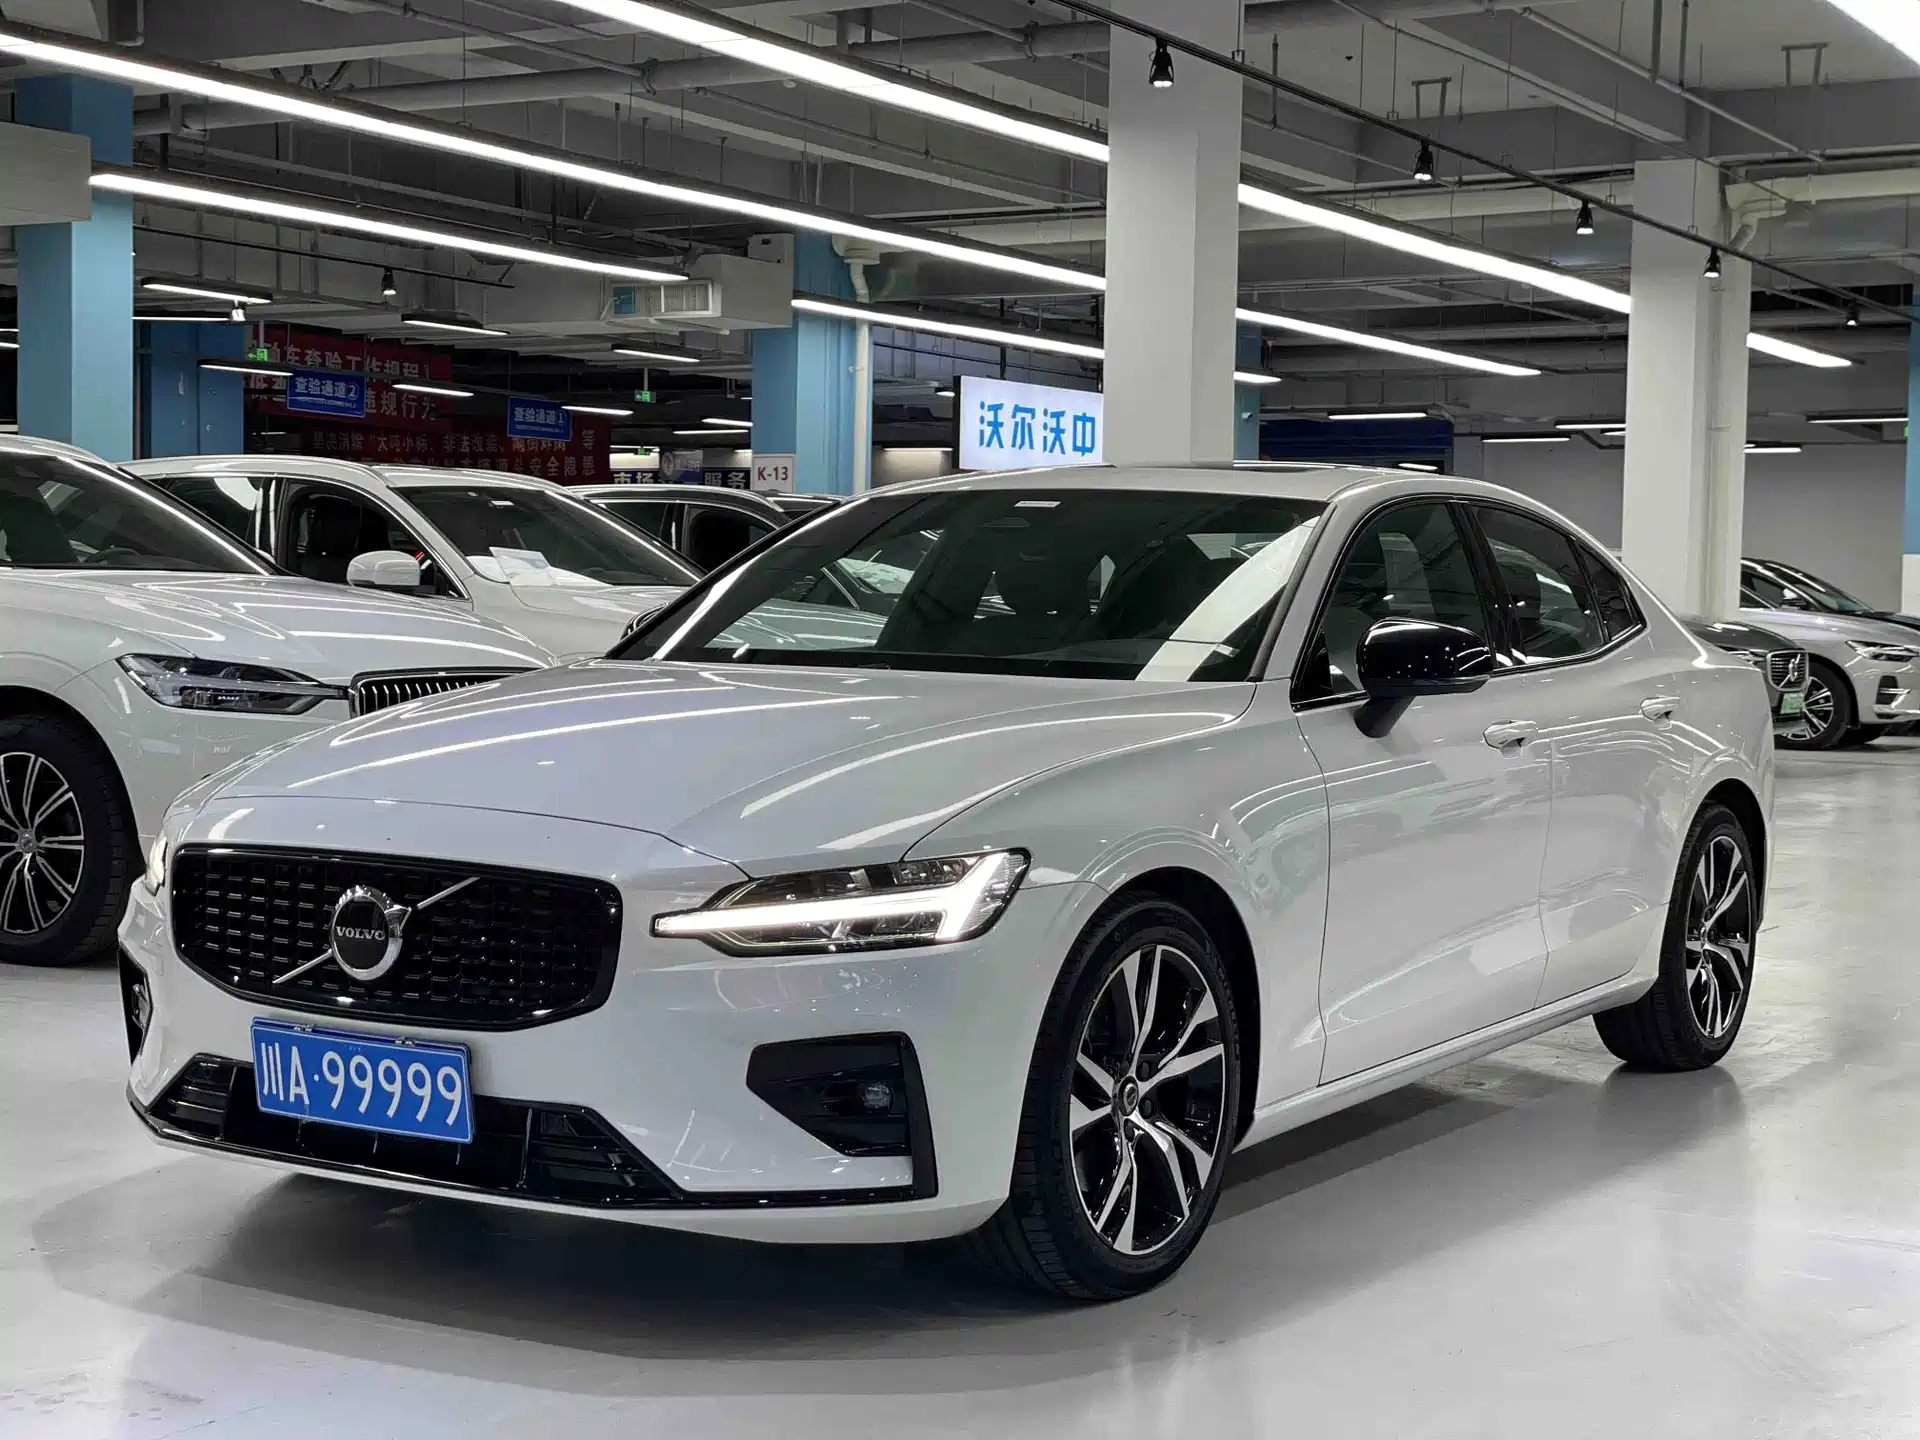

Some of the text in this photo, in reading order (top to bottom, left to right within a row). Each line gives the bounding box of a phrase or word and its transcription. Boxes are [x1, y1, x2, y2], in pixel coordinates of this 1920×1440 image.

[979, 400, 1096, 457] 沃尔沃中
[757, 465, 789, 482] K-13
[336, 926, 386, 941] VOLVO
[260, 1042, 462, 1126] 川A·99999
